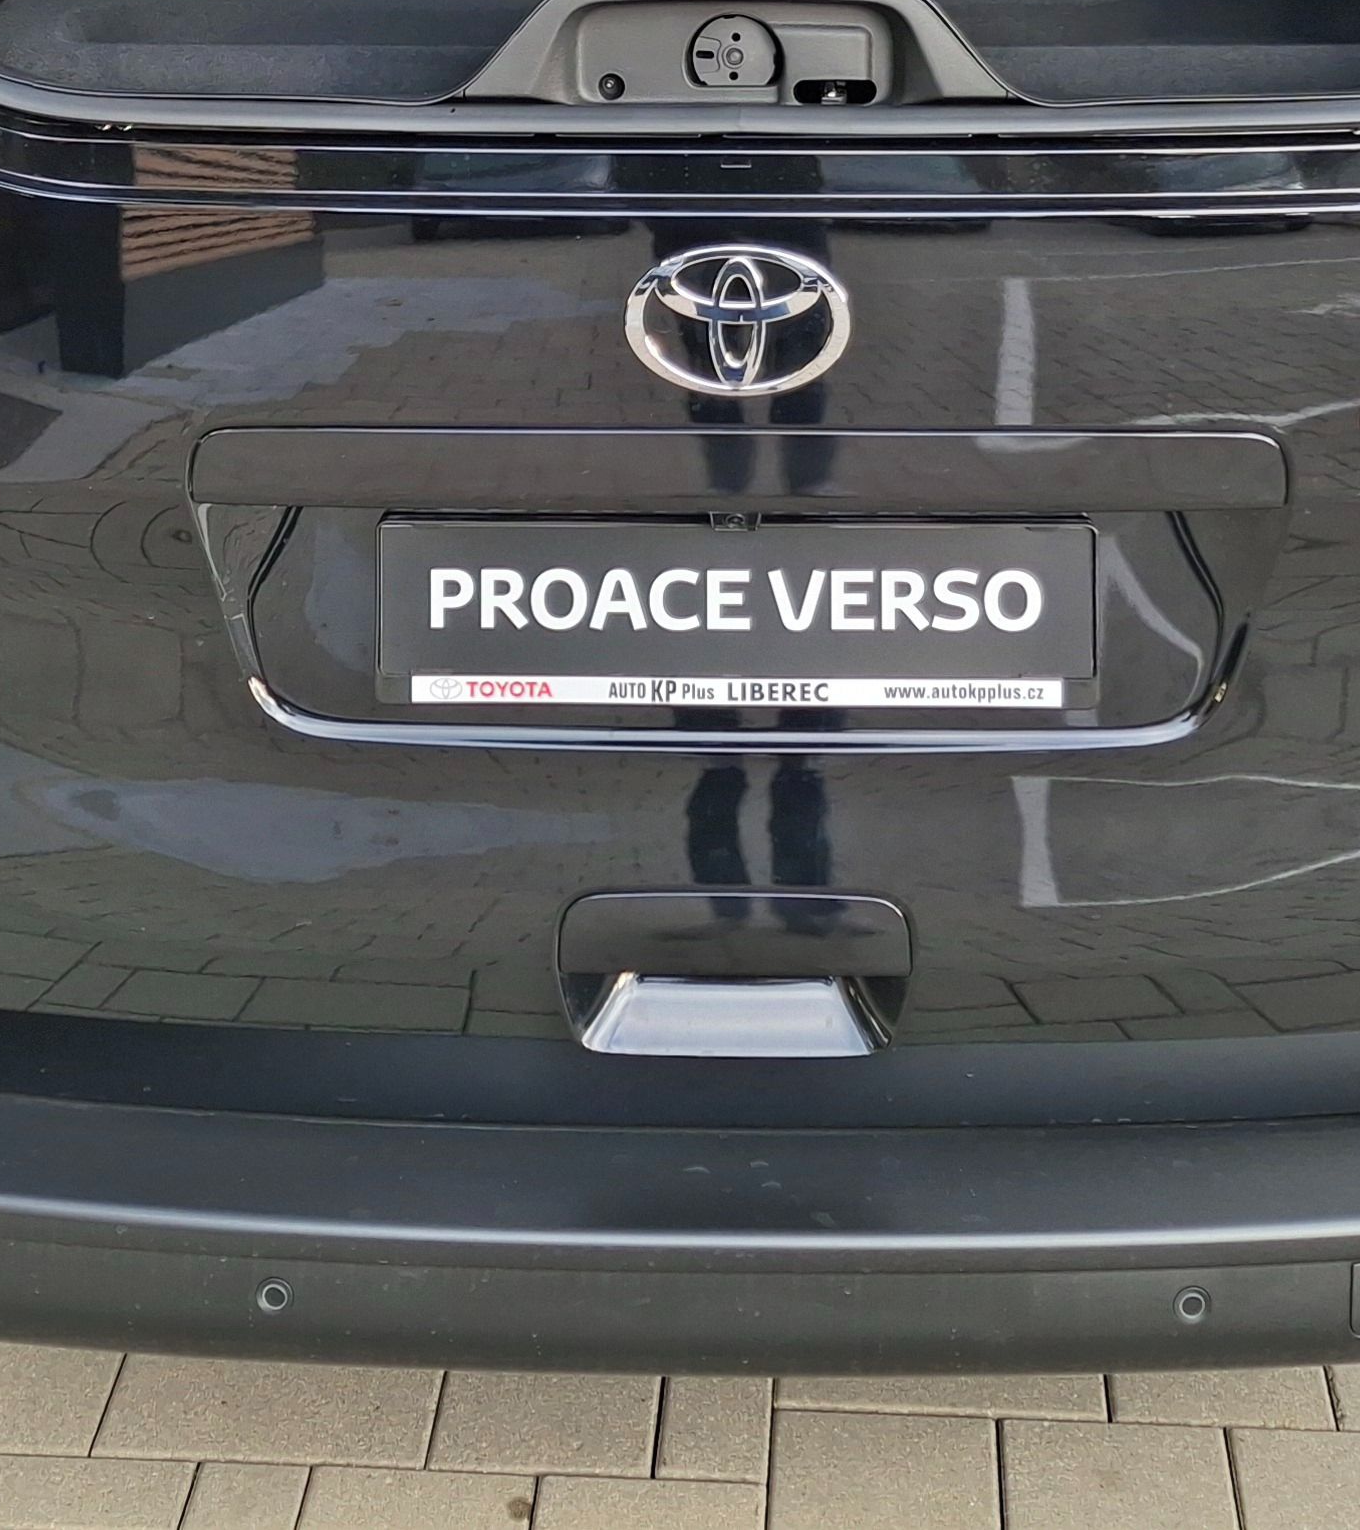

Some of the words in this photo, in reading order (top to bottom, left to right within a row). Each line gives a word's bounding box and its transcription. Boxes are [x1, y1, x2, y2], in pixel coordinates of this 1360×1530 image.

[429, 567, 753, 632] PROACE
[767, 568, 1043, 633] VERSO
[466, 680, 553, 699] TOYOTA
[608, 682, 646, 700] AUTO
[651, 679, 677, 703] KP
[681, 683, 715, 701] Plus
[727, 681, 830, 703] LIBEREC
[884, 682, 1045, 704] www.autokpplus.cz
